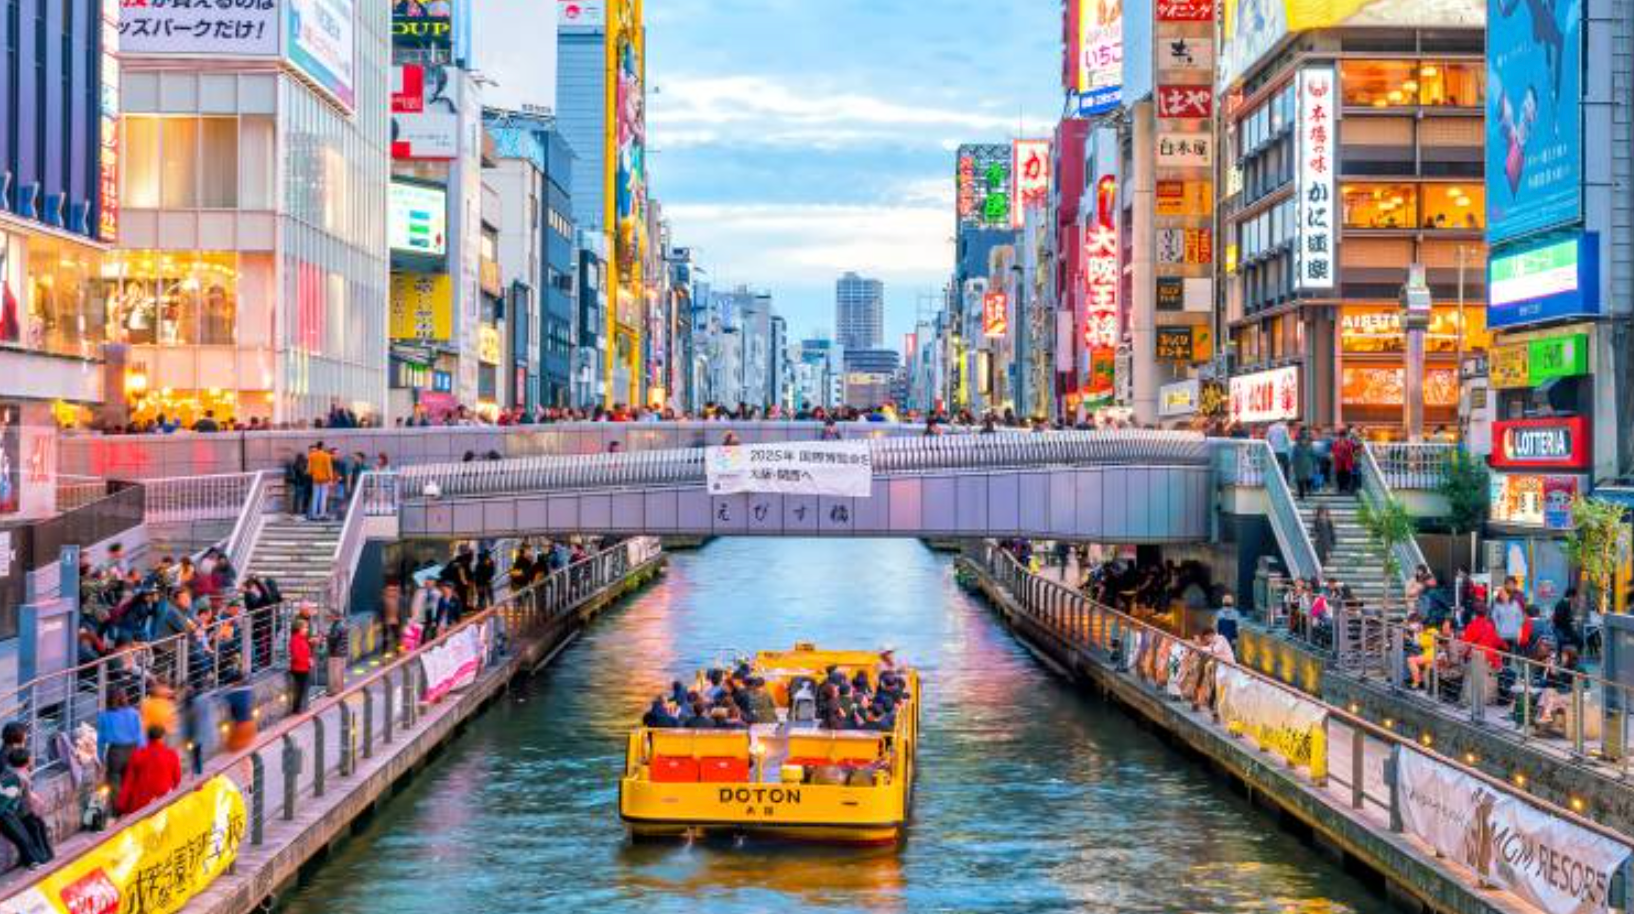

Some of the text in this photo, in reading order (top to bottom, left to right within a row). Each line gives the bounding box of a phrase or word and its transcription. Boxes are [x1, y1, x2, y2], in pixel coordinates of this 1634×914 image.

[1160, 137, 1207, 157] 白木屋
[1307, 104, 1329, 280] 本場の味 かに道楽
[1084, 224, 1117, 348] 大阪王将
[1515, 429, 1566, 455] LOTTERIA
[751, 450, 794, 463] 2025年
[717, 502, 849, 523] えびす橋
[720, 788, 801, 804] DOTON
